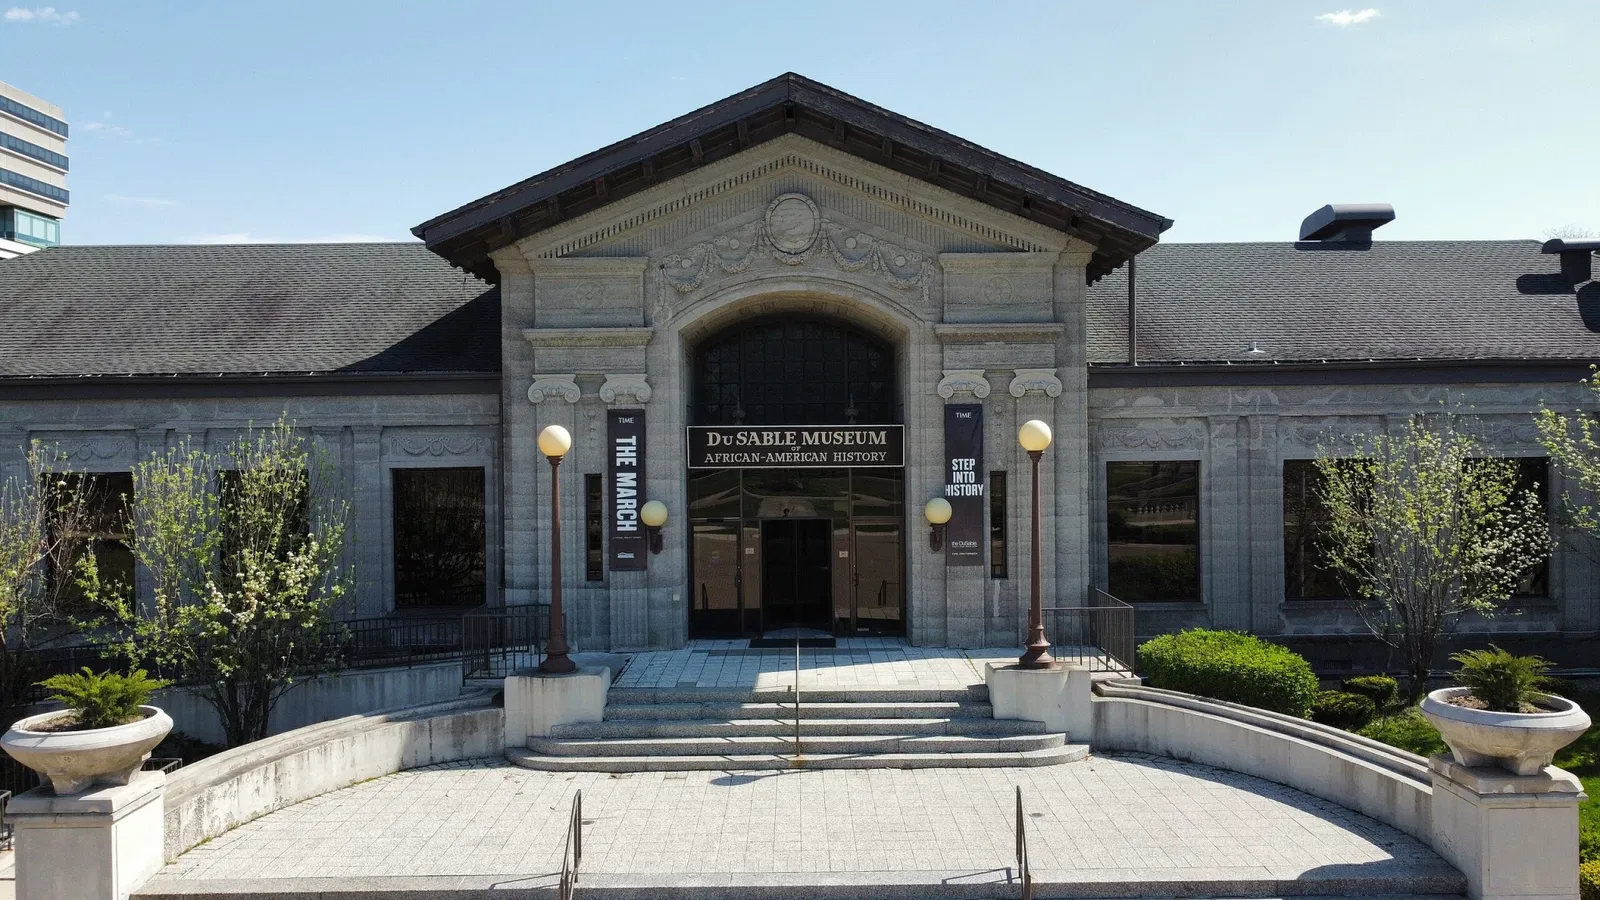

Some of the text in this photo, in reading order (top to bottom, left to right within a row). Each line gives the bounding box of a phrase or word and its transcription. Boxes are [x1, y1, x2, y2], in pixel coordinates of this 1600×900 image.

[801, 431, 887, 445] MUSEUM
[616, 436, 636, 466] THE
[704, 451, 887, 463] AFRICAN-AMERICAN HISTORY
[952, 458, 976, 470] STEP
[952, 471, 975, 484] INTO
[944, 484, 984, 496] HISTORY
[616, 472, 637, 531] MARCH
